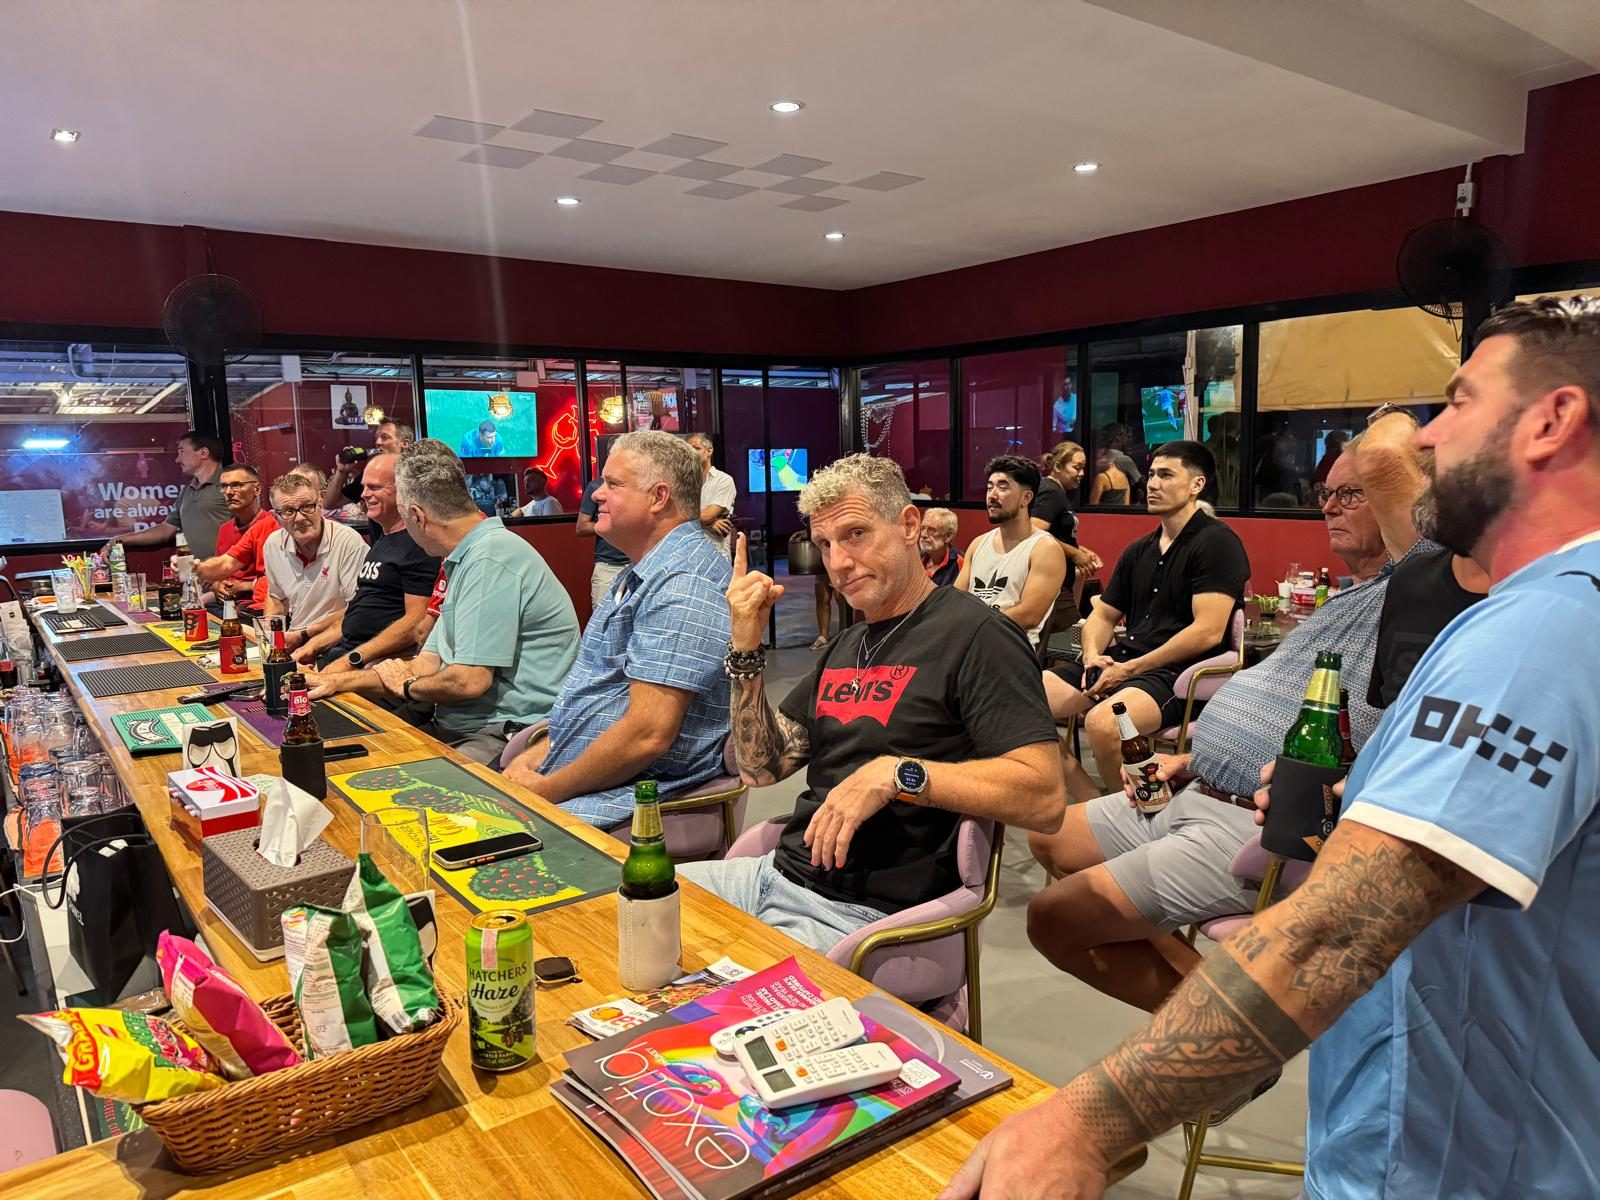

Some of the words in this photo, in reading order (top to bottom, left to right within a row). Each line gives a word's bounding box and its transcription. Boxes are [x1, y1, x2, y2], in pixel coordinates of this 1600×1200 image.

[94, 508, 123, 519] are
[360, 561, 381, 580] OSS
[1410, 695, 1568, 790] OKX
[470, 982, 520, 1000] Haze
[593, 1041, 751, 1170] exotiq
